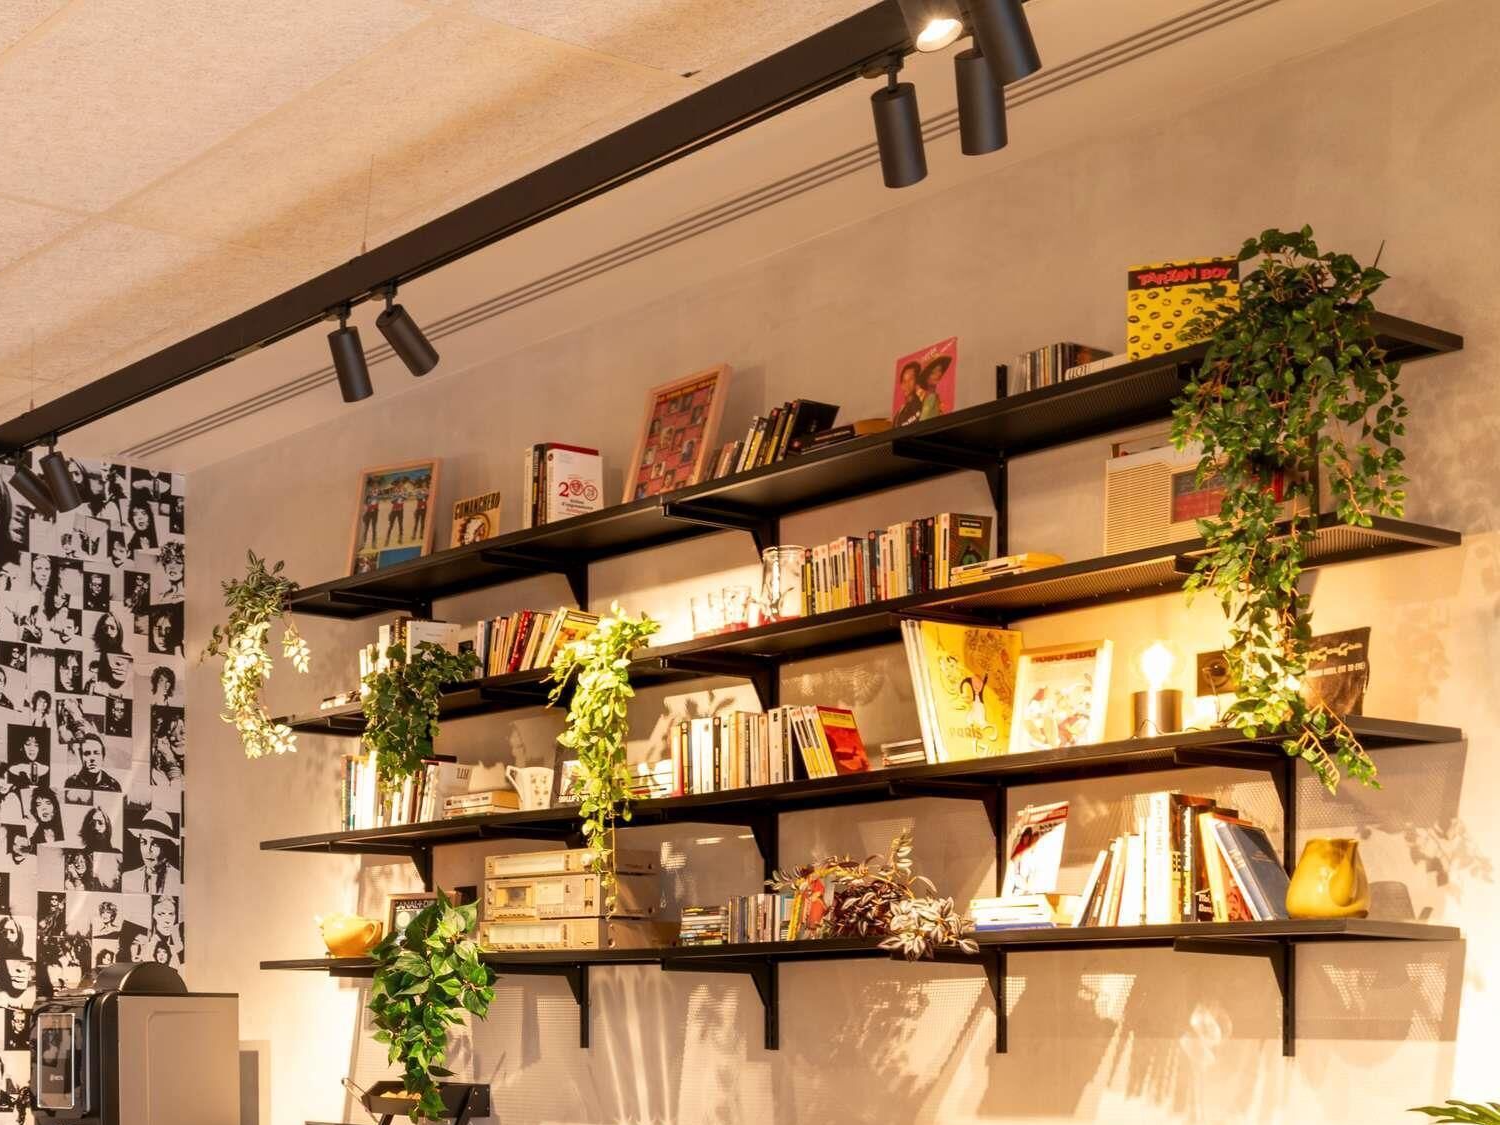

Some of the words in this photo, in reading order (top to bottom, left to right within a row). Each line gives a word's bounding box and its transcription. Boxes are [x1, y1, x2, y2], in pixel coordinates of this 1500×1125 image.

[1137, 267, 1197, 287] TARZAN
[1199, 266, 1233, 281] BOY
[454, 491, 501, 521] COMANCHERO
